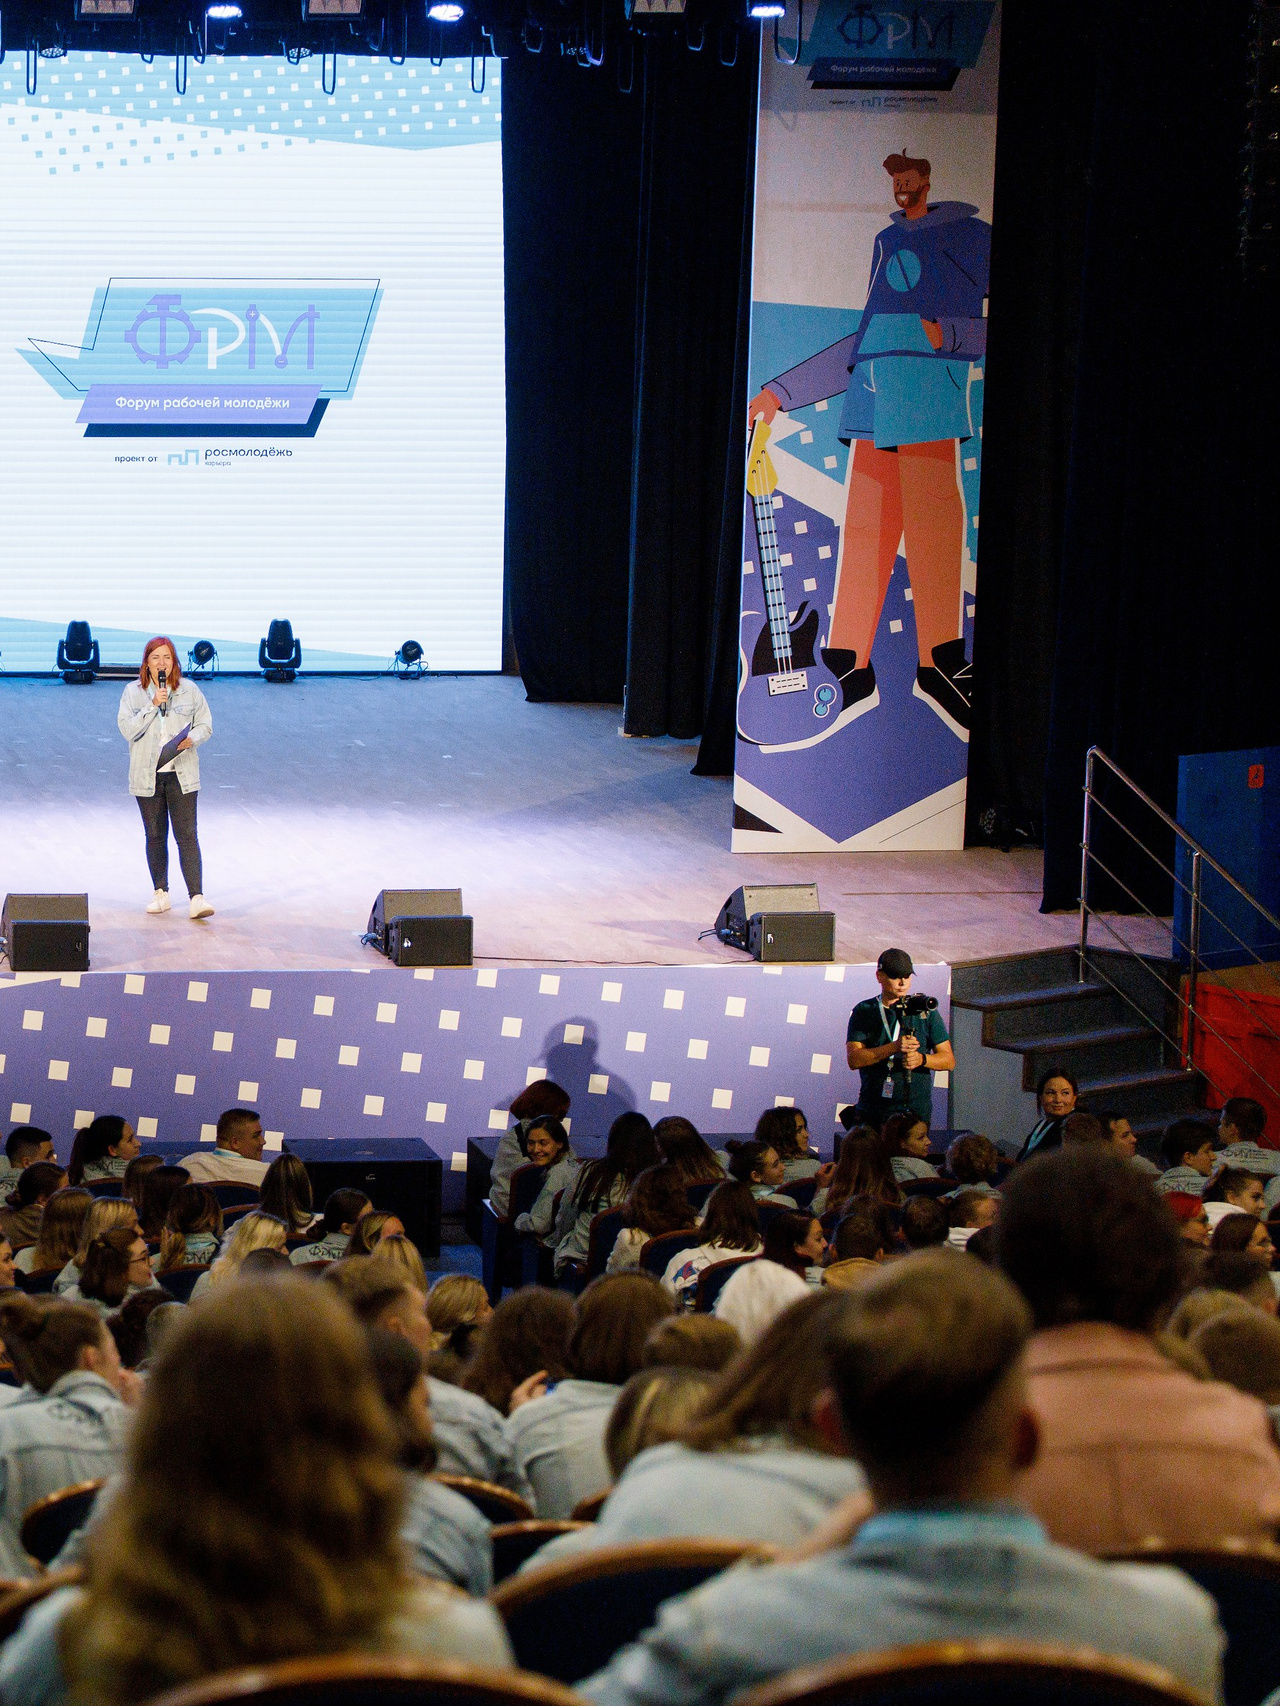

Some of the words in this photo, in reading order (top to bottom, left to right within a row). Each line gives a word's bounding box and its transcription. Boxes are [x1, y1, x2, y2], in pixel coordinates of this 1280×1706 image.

[836, 4, 957, 49] ФРМ
[124, 294, 320, 369] ФРМ
[115, 396, 161, 411] Форум
[163, 396, 220, 411] рабочей
[224, 396, 290, 411] молодёжи
[114, 456, 145, 464] проект
[205, 447, 293, 460] росмолодёжь
